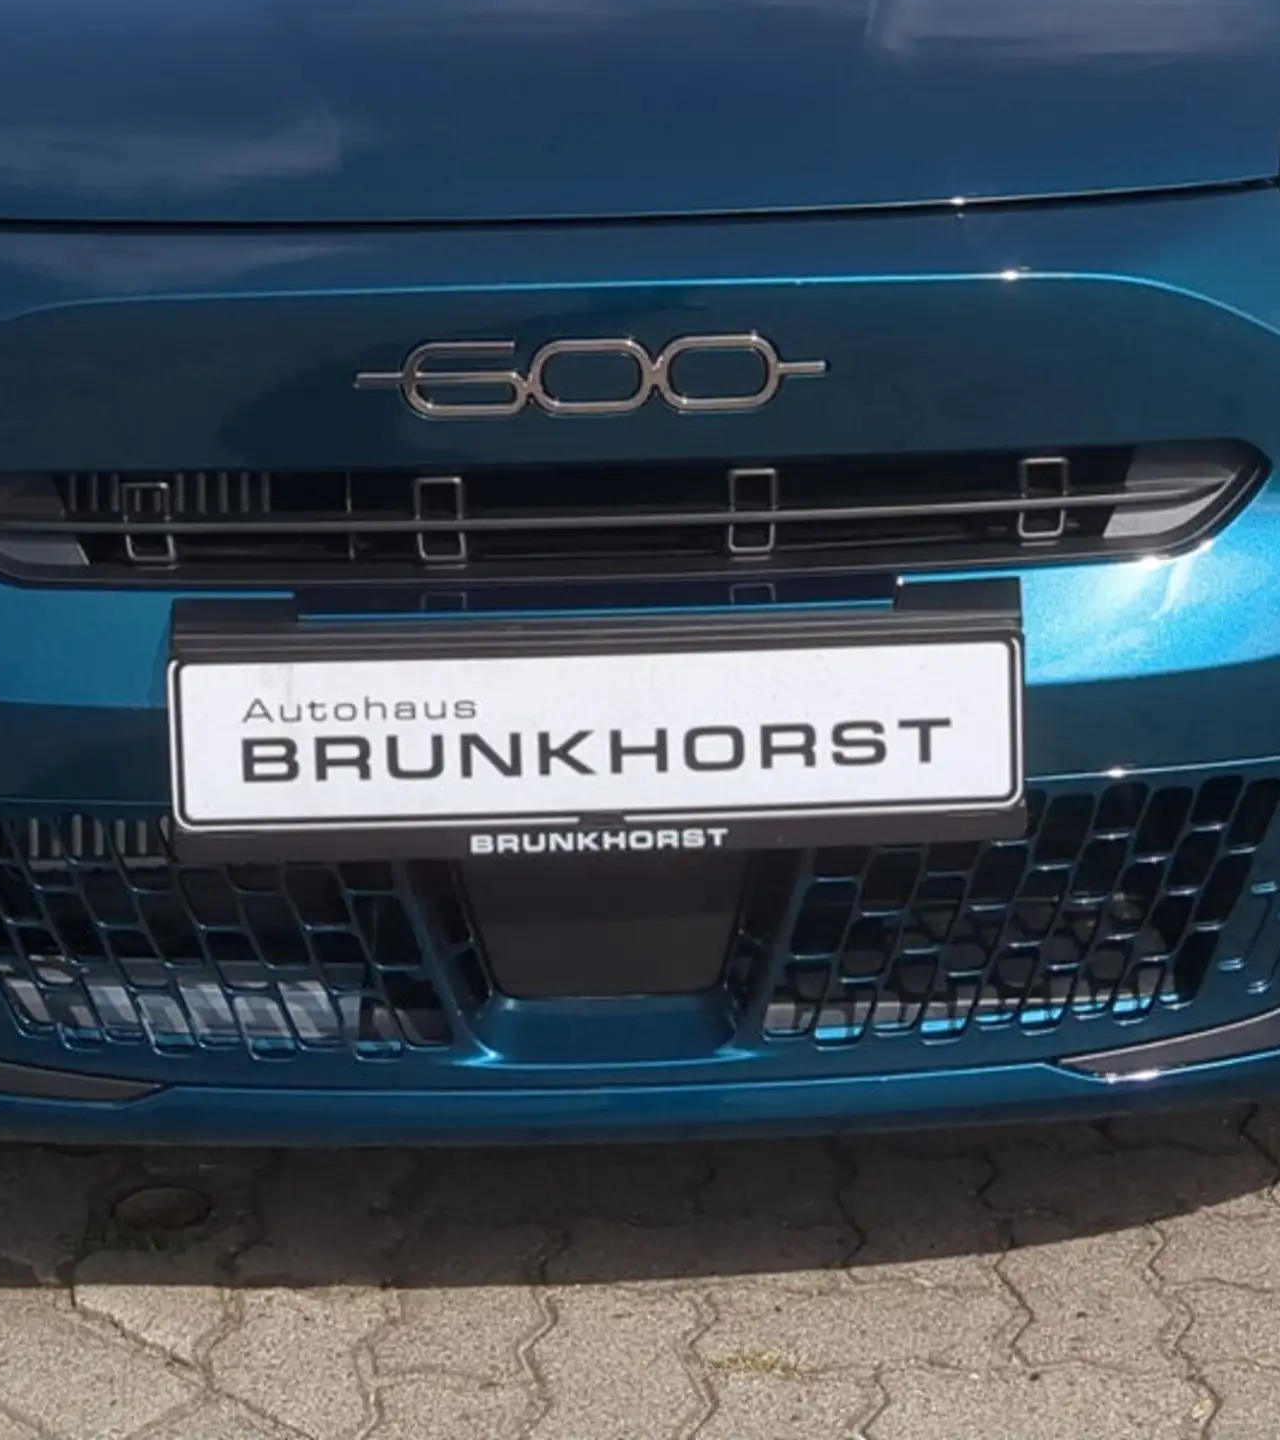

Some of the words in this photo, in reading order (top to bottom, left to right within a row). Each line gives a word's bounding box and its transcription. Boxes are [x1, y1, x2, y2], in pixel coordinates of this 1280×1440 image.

[404, 334, 780, 417] 600
[241, 696, 477, 724] Autohaus
[241, 717, 952, 783] BRUNKHORST
[470, 828, 729, 855] BRUNKHORST
